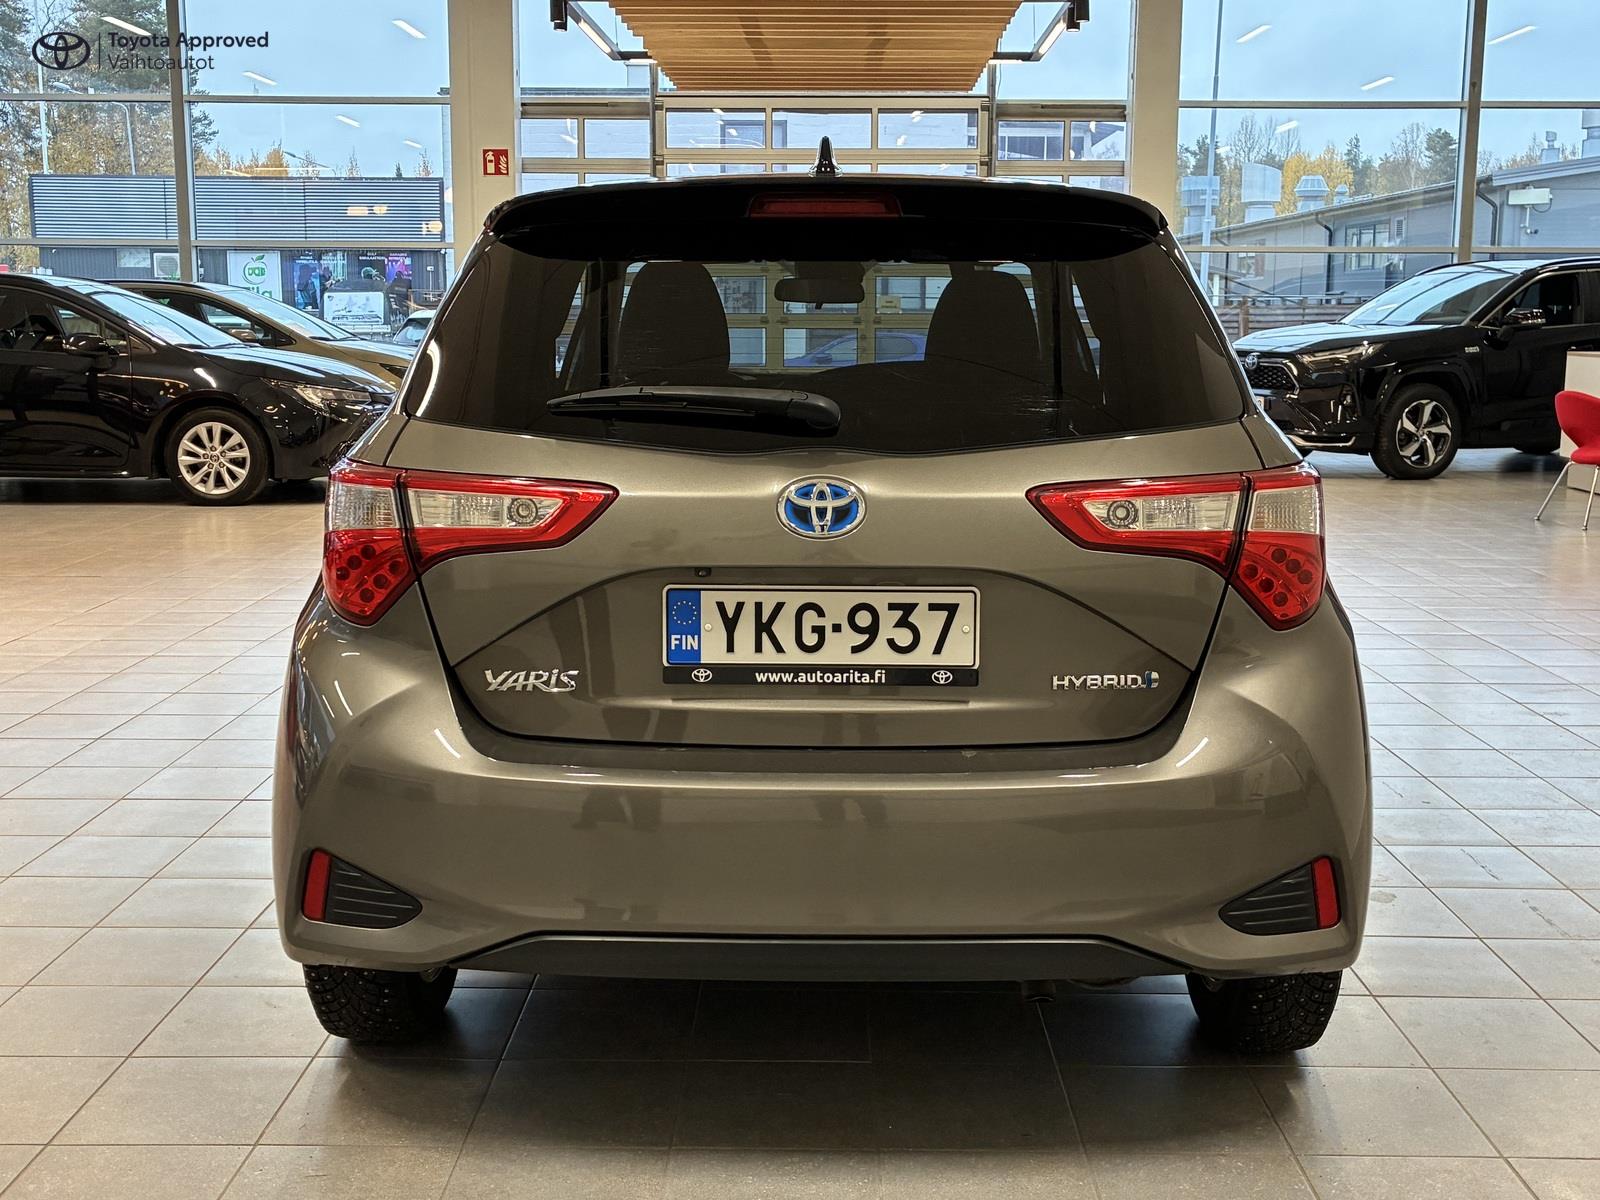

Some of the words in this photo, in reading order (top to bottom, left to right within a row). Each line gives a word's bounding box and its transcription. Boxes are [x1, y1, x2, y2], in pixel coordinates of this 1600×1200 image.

[715, 600, 960, 655] YKG-937
[671, 634, 698, 650] FIN
[755, 669, 886, 684] www.autoarita.fi
[1052, 674, 1142, 690] HYBRID
